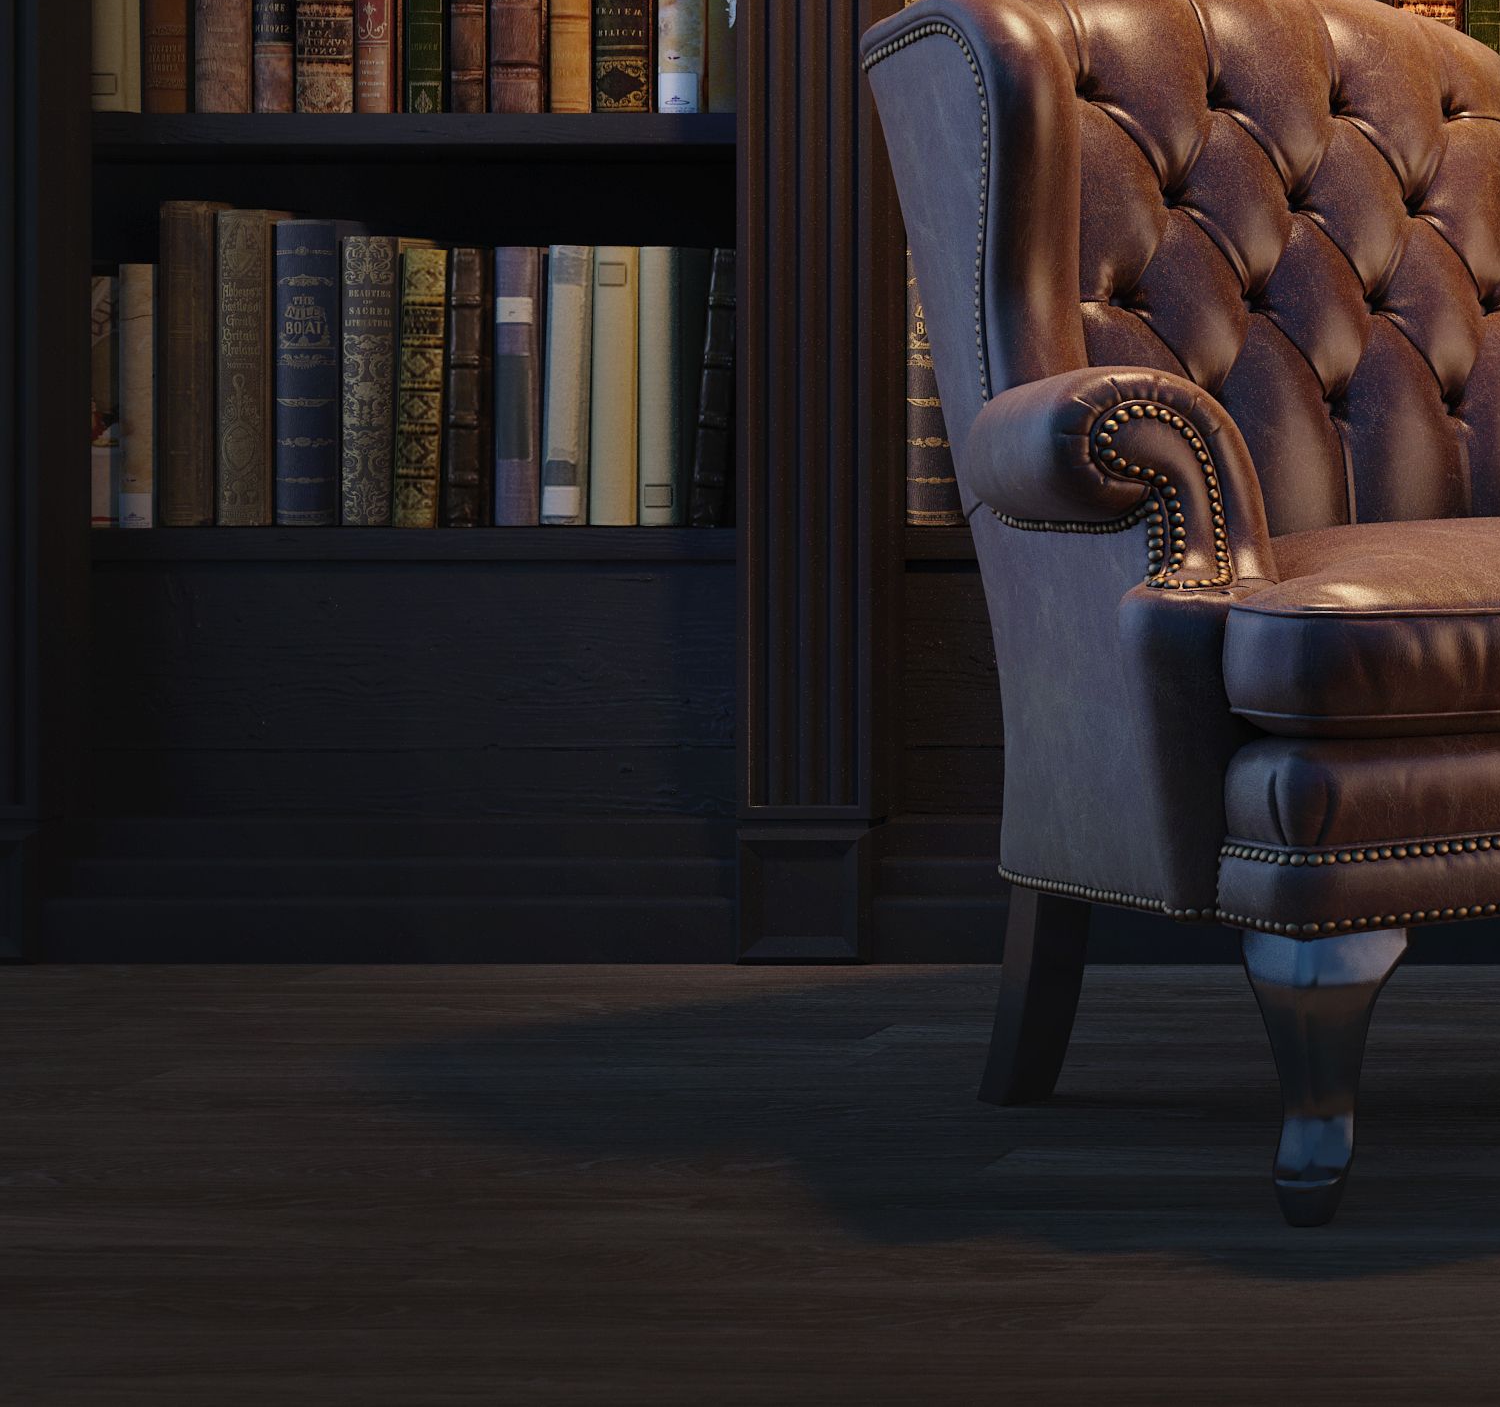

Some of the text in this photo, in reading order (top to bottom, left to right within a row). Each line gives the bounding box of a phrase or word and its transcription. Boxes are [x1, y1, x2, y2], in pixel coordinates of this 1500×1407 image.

[292, 296, 315, 306] THE
[285, 306, 321, 318] NILE
[348, 307, 390, 316] SACRED
[284, 321, 322, 335] BOAT
